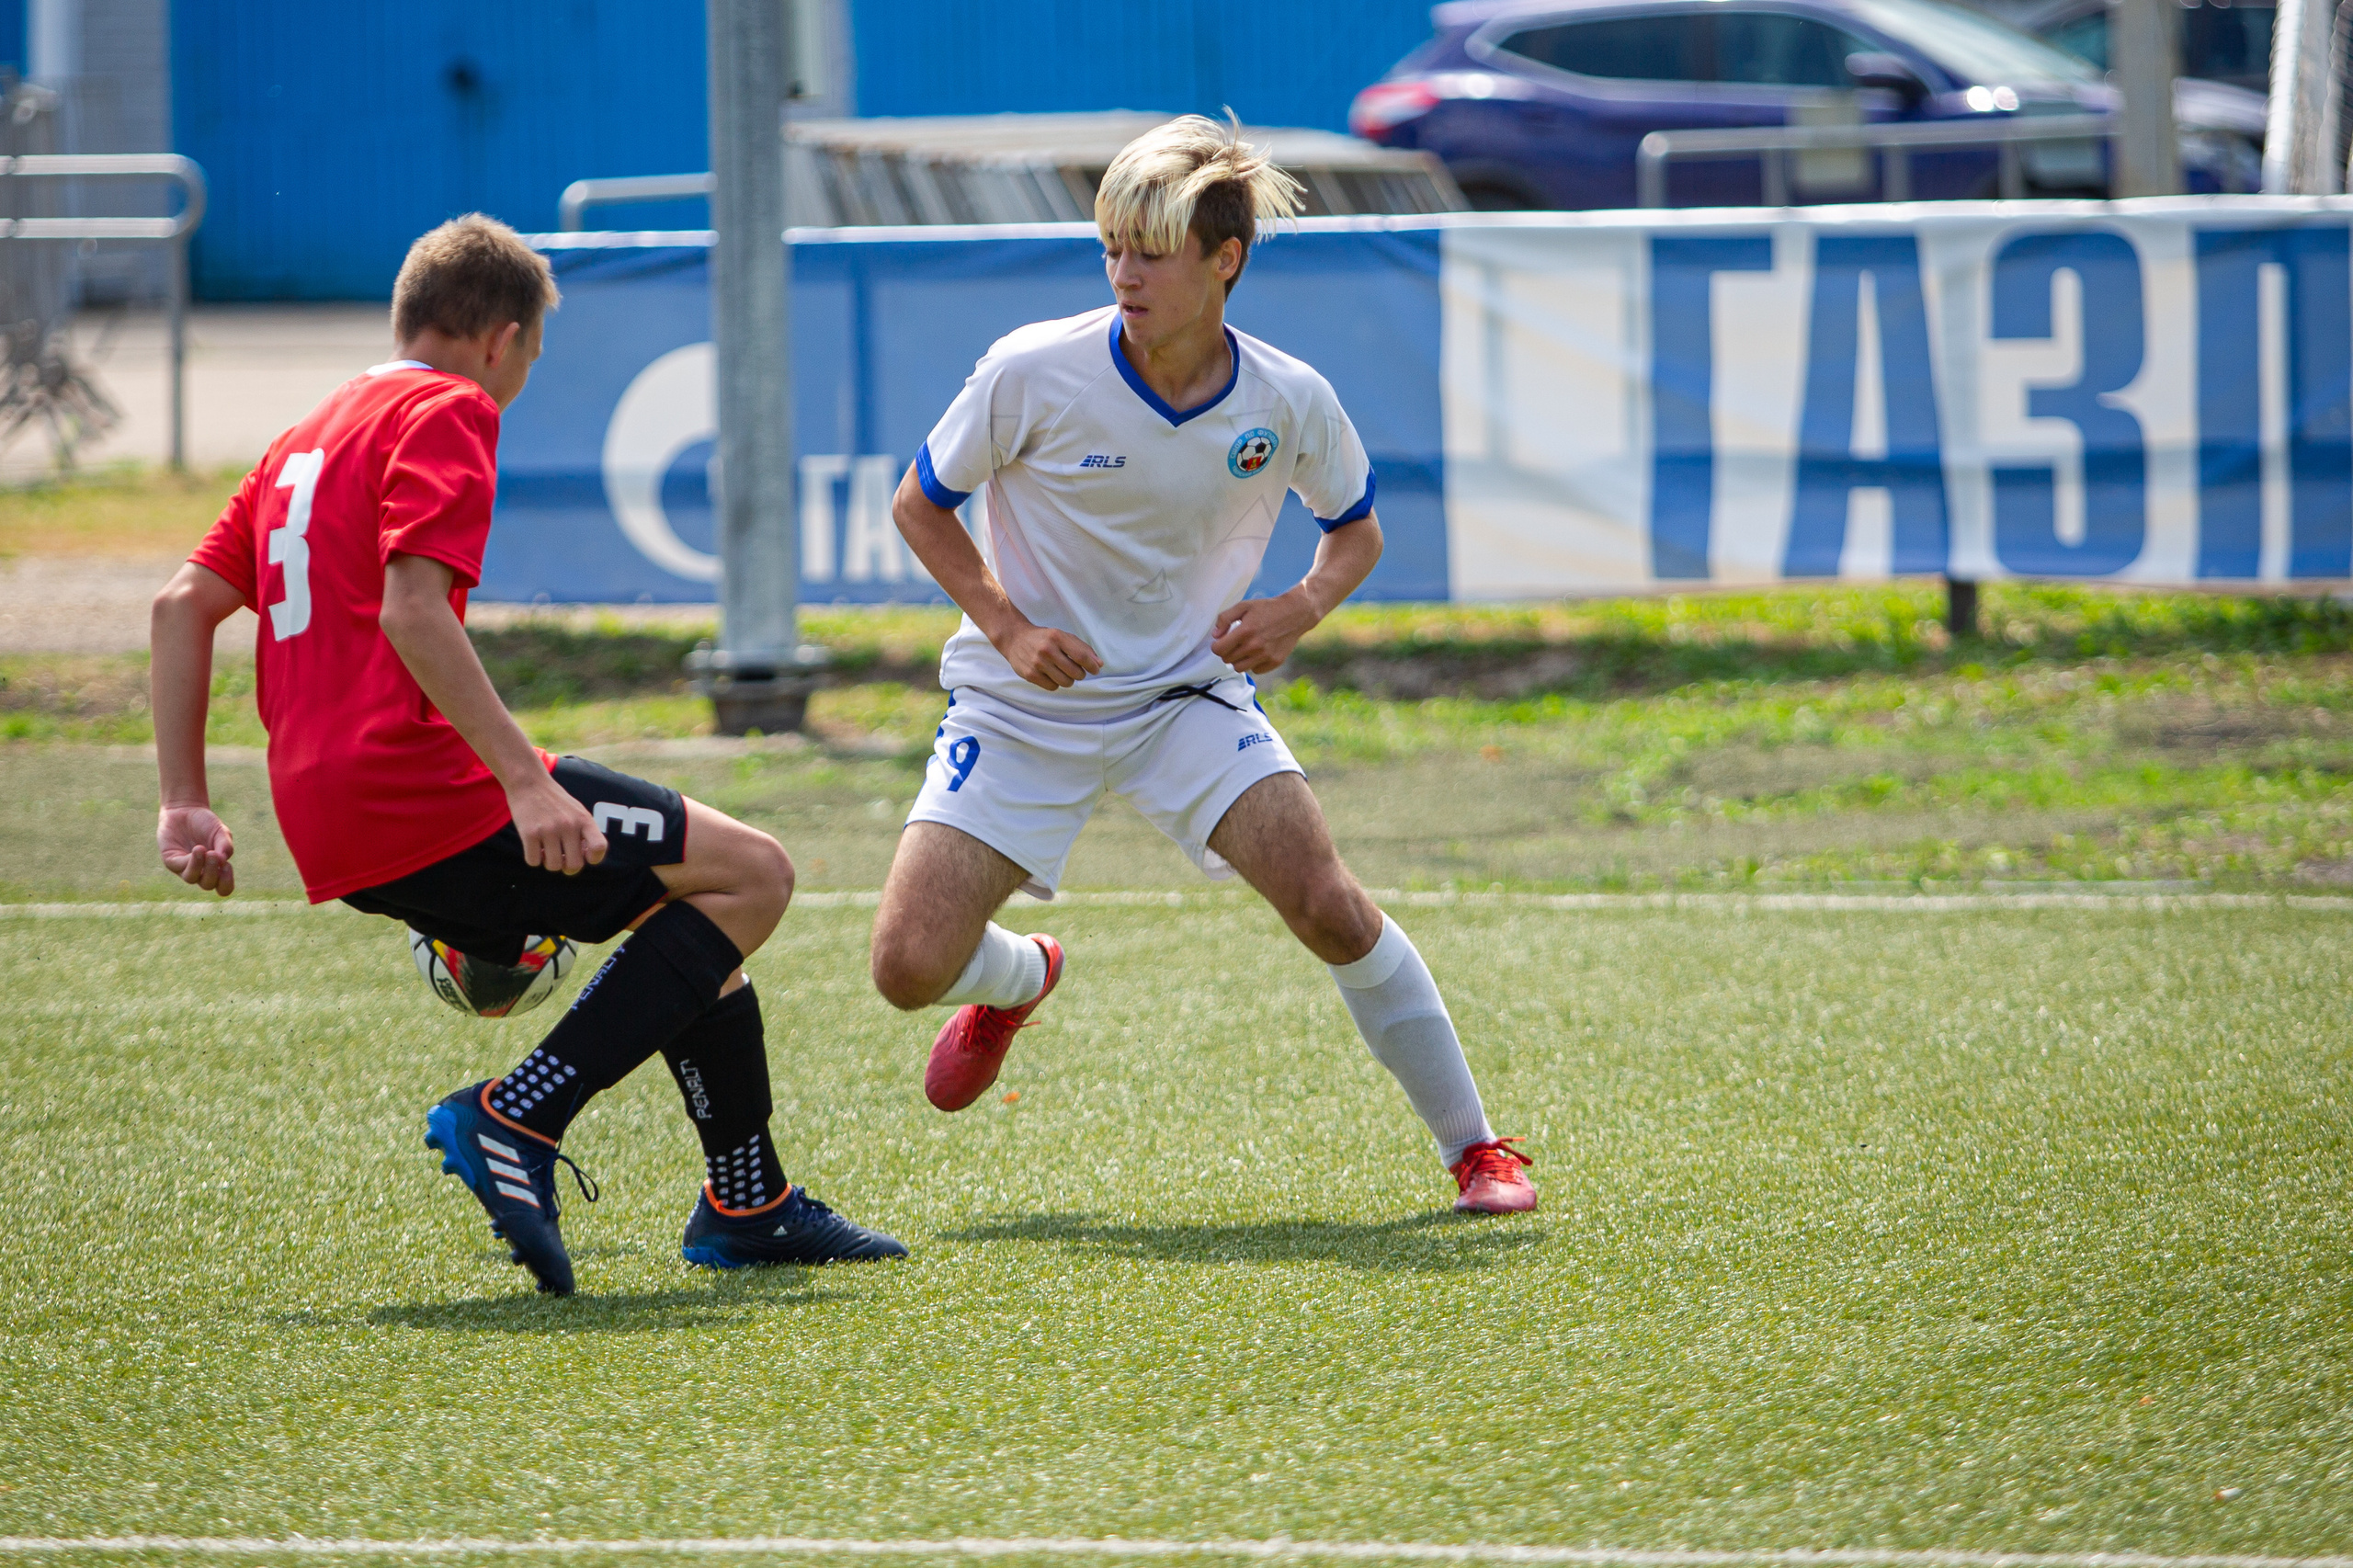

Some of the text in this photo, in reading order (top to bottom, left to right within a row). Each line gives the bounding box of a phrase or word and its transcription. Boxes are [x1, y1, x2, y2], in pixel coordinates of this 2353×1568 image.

[1648, 232, 2351, 580] ГАЗП
[1089, 455, 1127, 468] RLS
[268, 448, 325, 642] 3
[1245, 732, 1273, 746] RLS
[593, 801, 665, 842] 3
